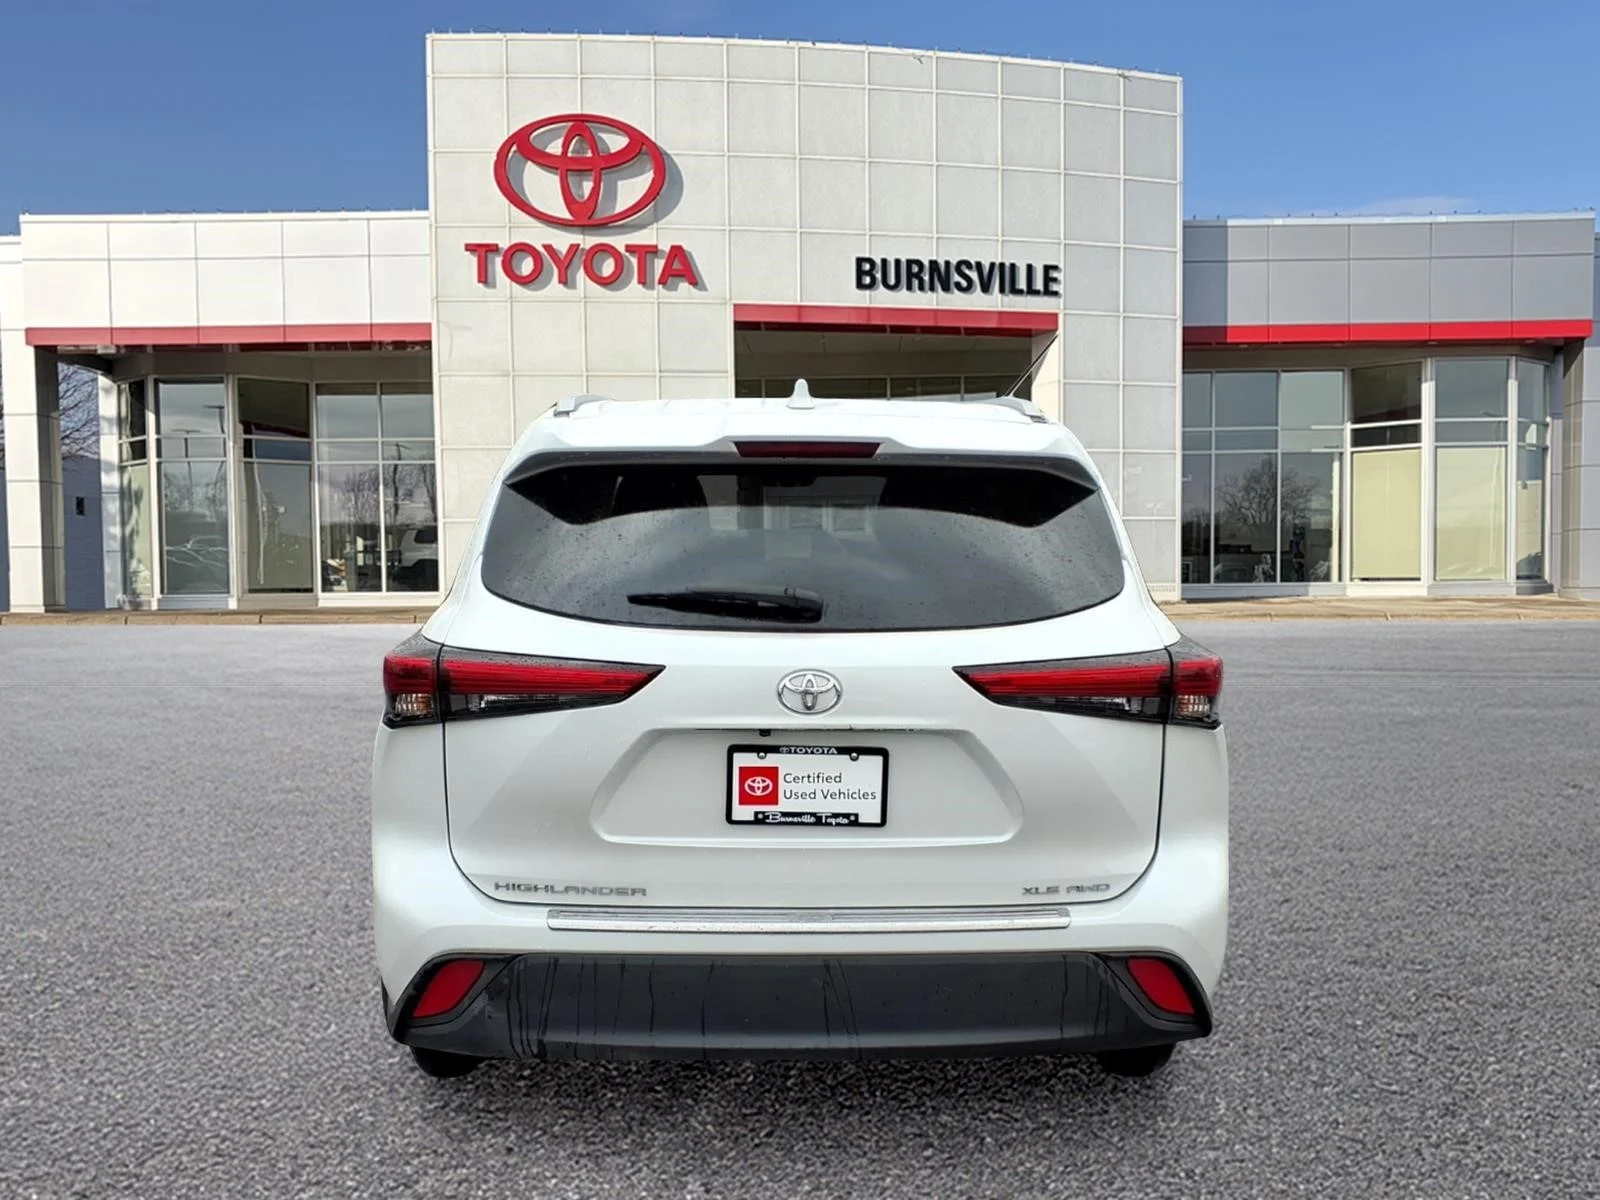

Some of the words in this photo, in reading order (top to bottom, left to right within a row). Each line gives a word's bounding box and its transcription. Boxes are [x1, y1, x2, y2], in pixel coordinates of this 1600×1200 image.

[464, 242, 698, 287] TOYOTA
[855, 256, 1061, 296] BURNSVILLE
[783, 772, 842, 784] Certified
[783, 789, 817, 800] Used
[821, 789, 877, 800] Vehicles
[765, 811, 816, 824] Burnsville
[816, 812, 849, 826] Toyota
[494, 881, 648, 897] HIGHLANDER
[1022, 886, 1060, 895] XLE
[1066, 883, 1110, 894] AWD
